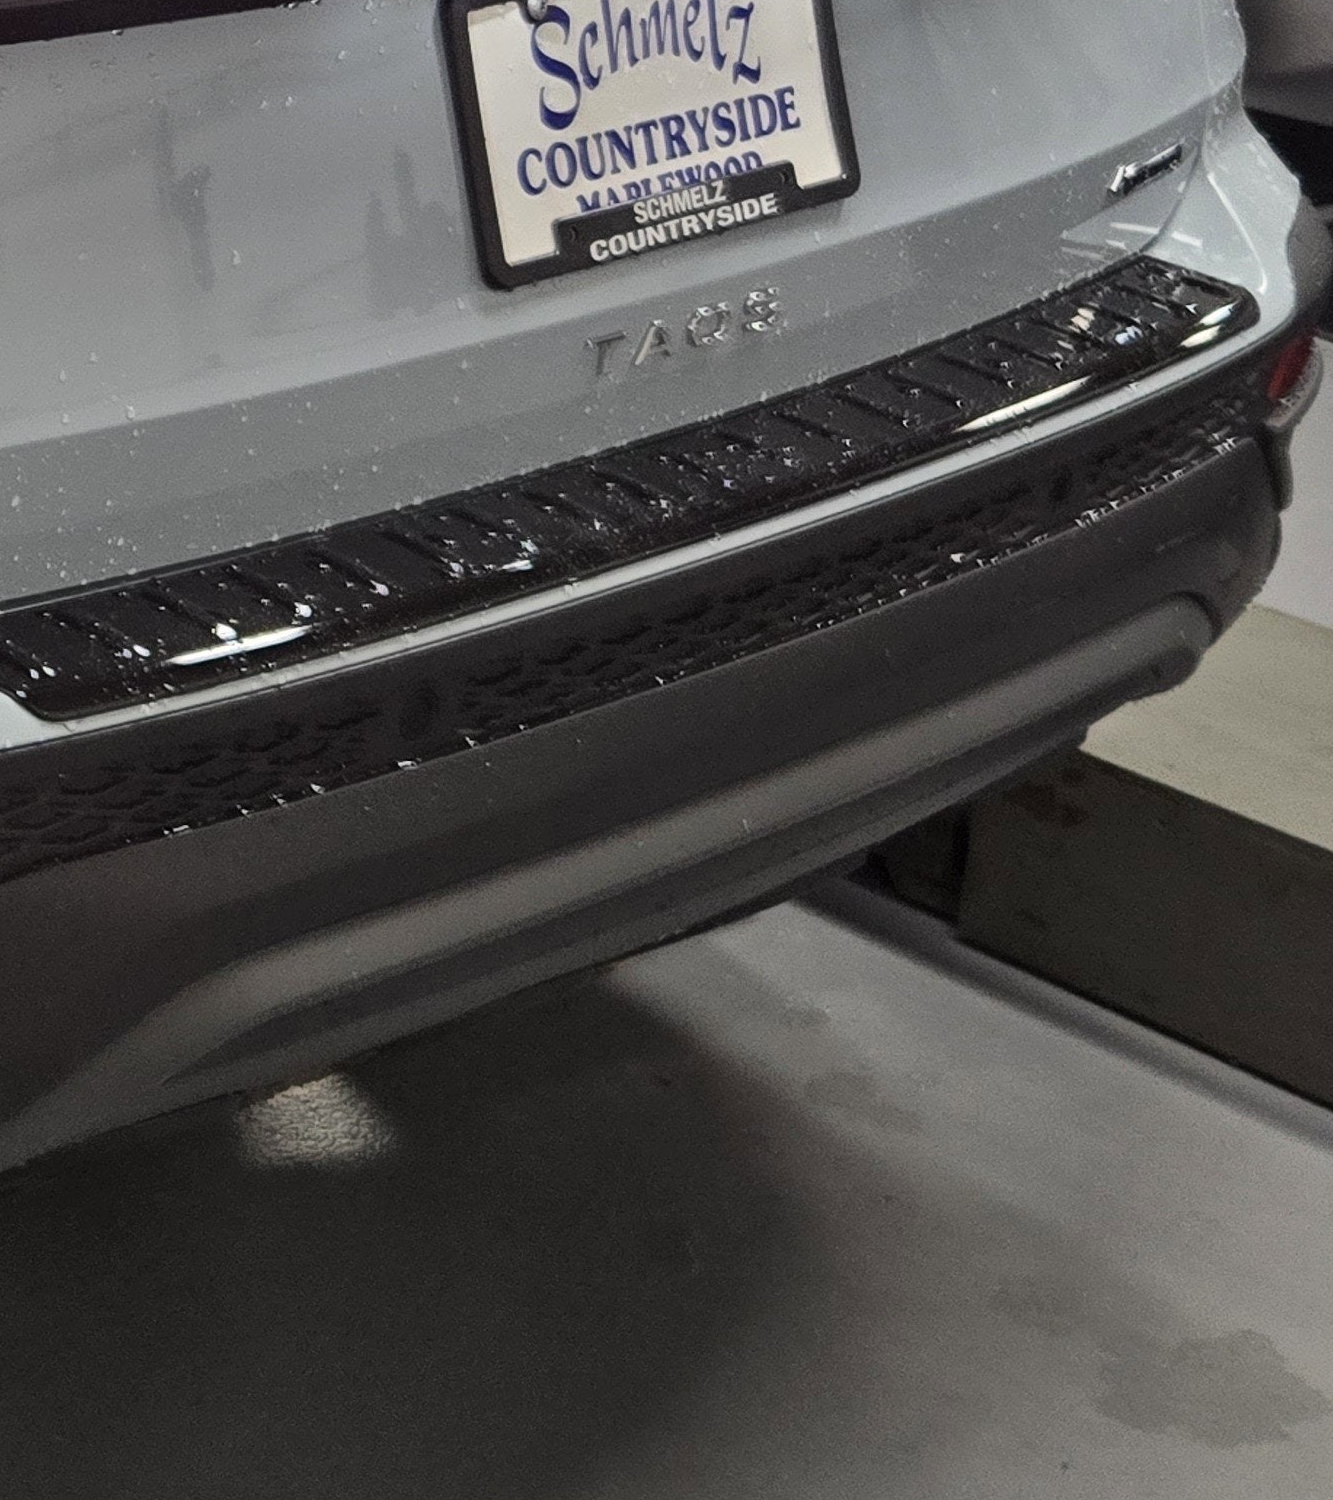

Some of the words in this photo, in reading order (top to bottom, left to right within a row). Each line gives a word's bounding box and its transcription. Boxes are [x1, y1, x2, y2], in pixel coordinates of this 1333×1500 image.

[517, 85, 802, 197] COUNTRYSIDE
[589, 192, 779, 263] COUNTRYSIDE
[633, 179, 728, 225] SCHMELZ
